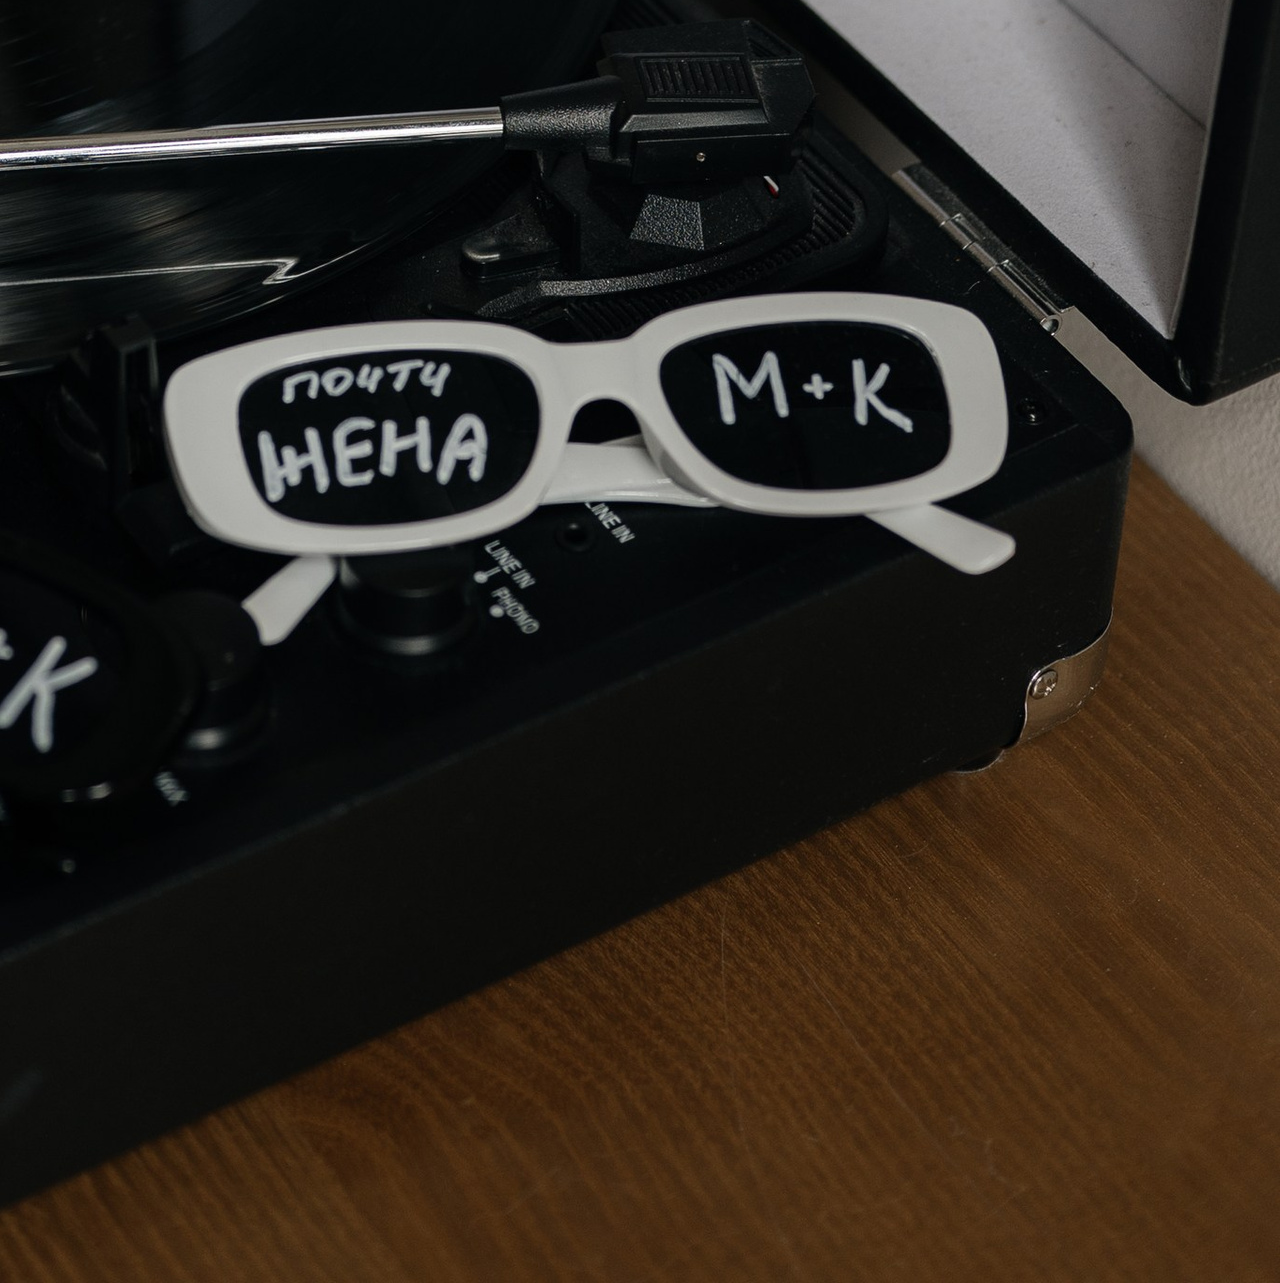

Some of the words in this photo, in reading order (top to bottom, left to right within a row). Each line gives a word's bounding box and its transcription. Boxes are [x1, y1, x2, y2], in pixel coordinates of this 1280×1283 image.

[258, 413, 488, 503] ЖЕНА
[611, 524, 636, 544] IN
[484, 539, 523, 574] LINE
[511, 569, 536, 589] IN
[491, 586, 540, 634] PHONO
